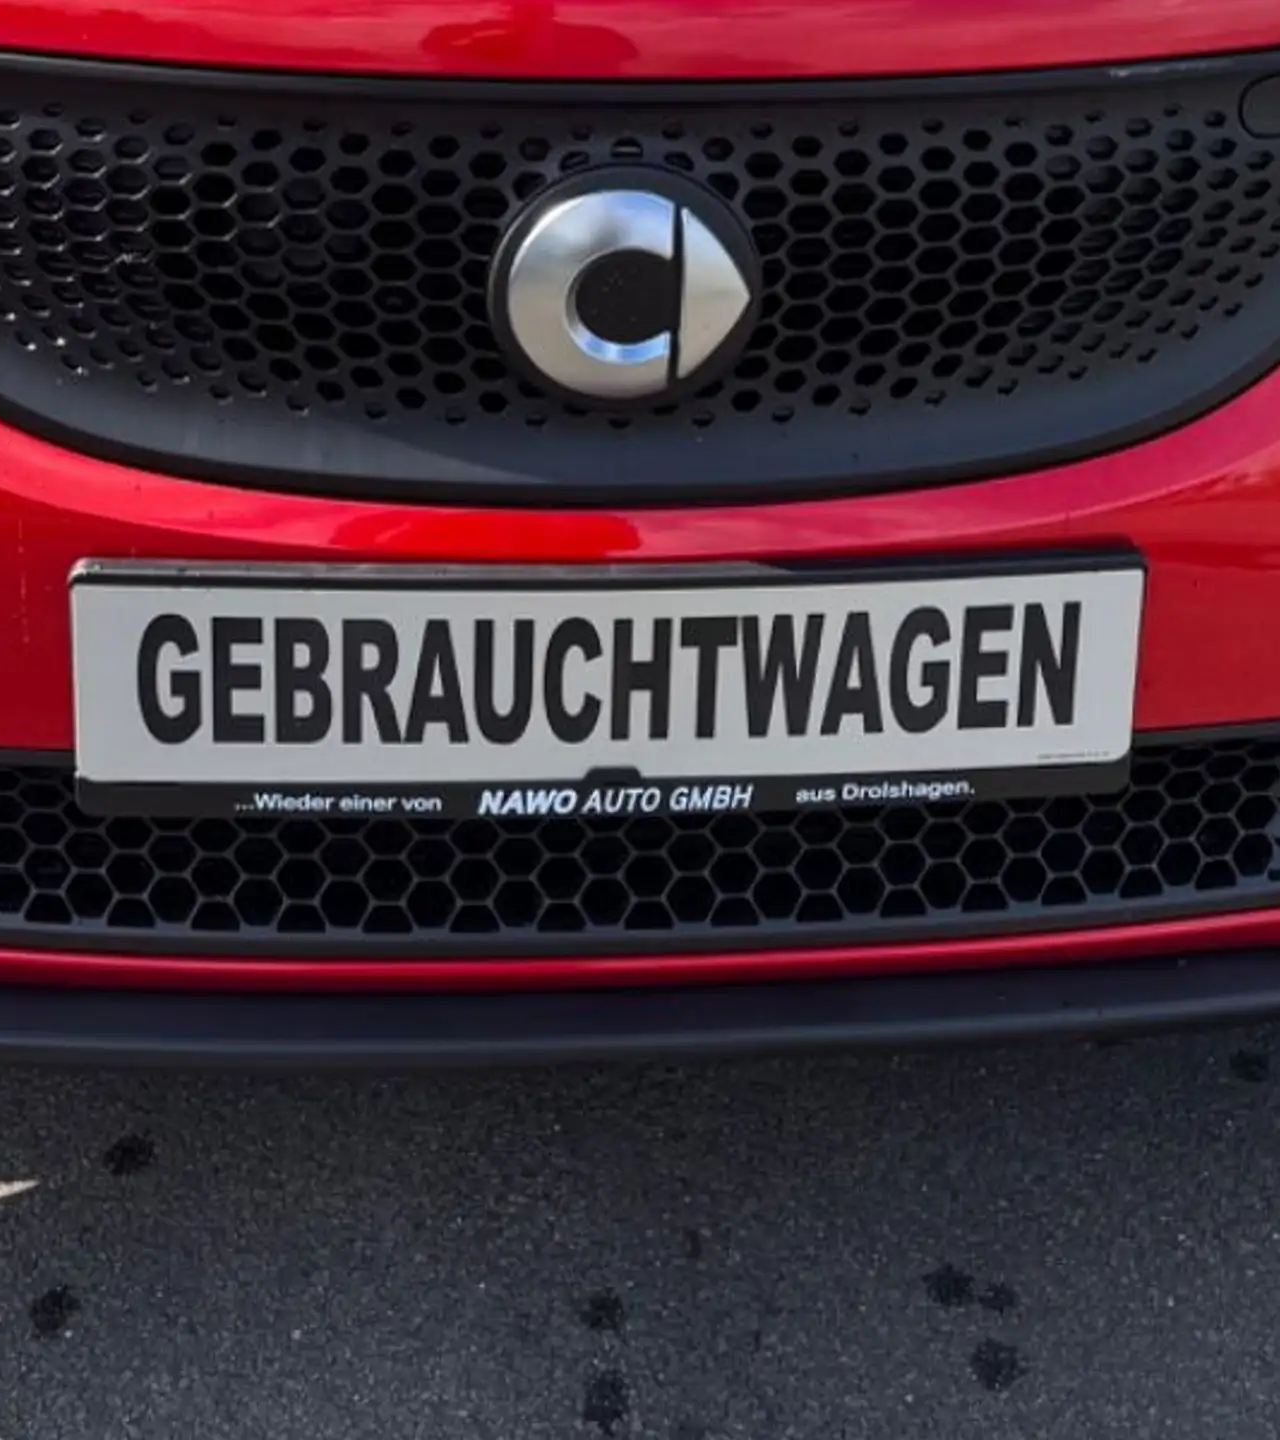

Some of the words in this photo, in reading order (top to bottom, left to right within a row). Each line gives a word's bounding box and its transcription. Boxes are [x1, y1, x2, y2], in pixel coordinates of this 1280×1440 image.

[136, 600, 1083, 745] GEBRAUCHTWAGEN
[338, 794, 396, 812] einer
[401, 796, 442, 812] von
[478, 789, 577, 815] NAWO
[580, 787, 661, 814] AUTO
[669, 783, 753, 811] GMBH
[795, 788, 836, 804] aus
